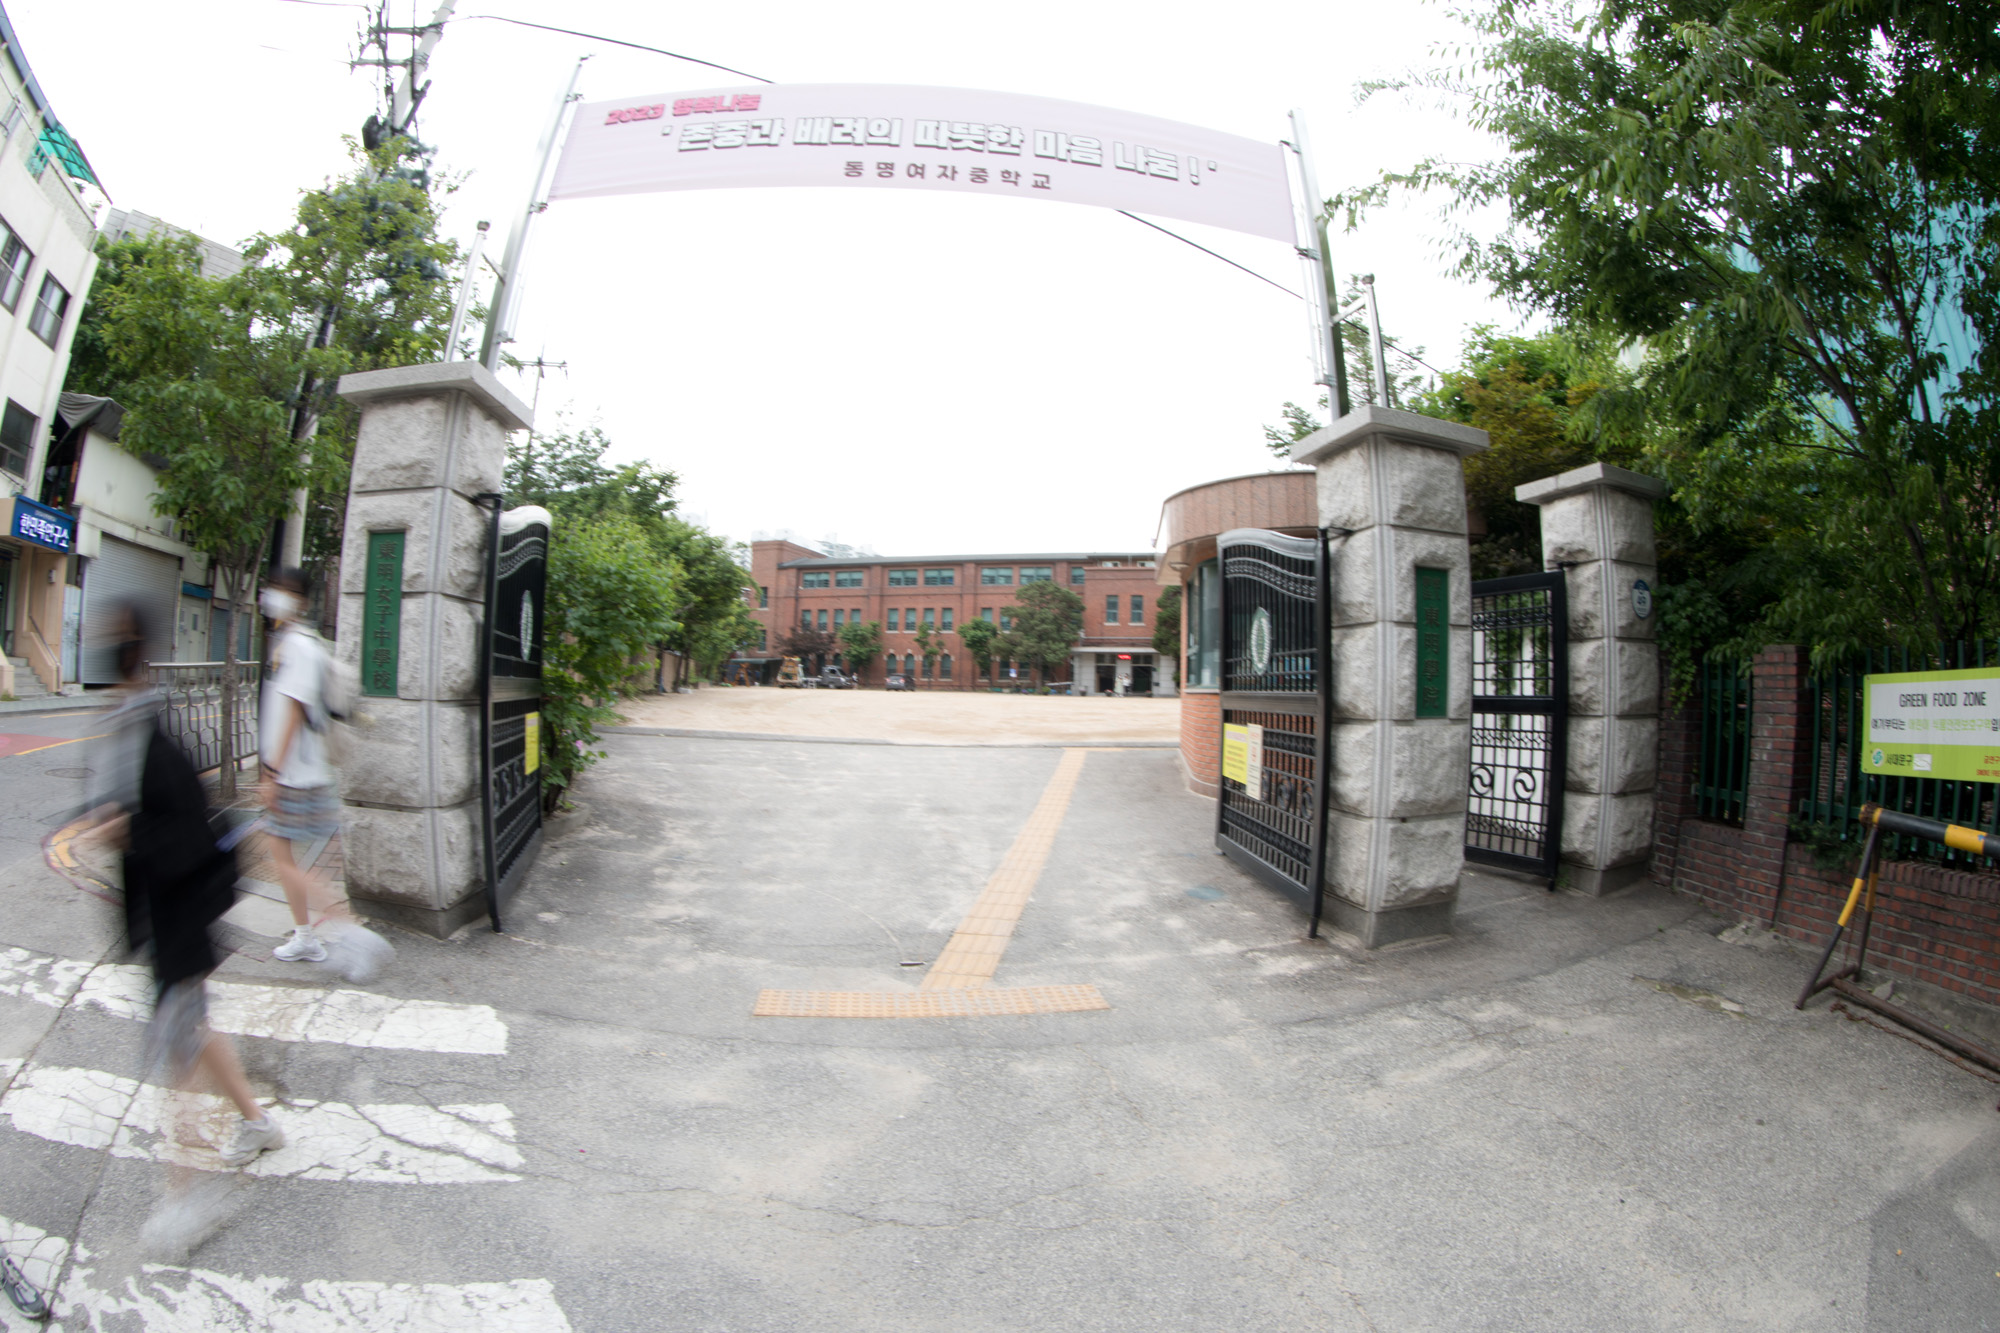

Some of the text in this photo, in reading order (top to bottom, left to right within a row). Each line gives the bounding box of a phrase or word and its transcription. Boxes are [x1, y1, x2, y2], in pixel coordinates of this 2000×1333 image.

[604, 93, 762, 126] 2023 행복나눔
[793, 117, 903, 146] 배려의
[914, 118, 1025, 156] 따뜻한
[1035, 129, 1103, 167] 마음
[1113, 141, 1179, 180] 나눔
[844, 160, 1052, 190] 동명여자중학교
[1899, 691, 1987, 708] GREEN FOOD ZONE
[1871, 718, 1906, 731] 여기부터는
[1886, 753, 1913, 766] 서대문구
